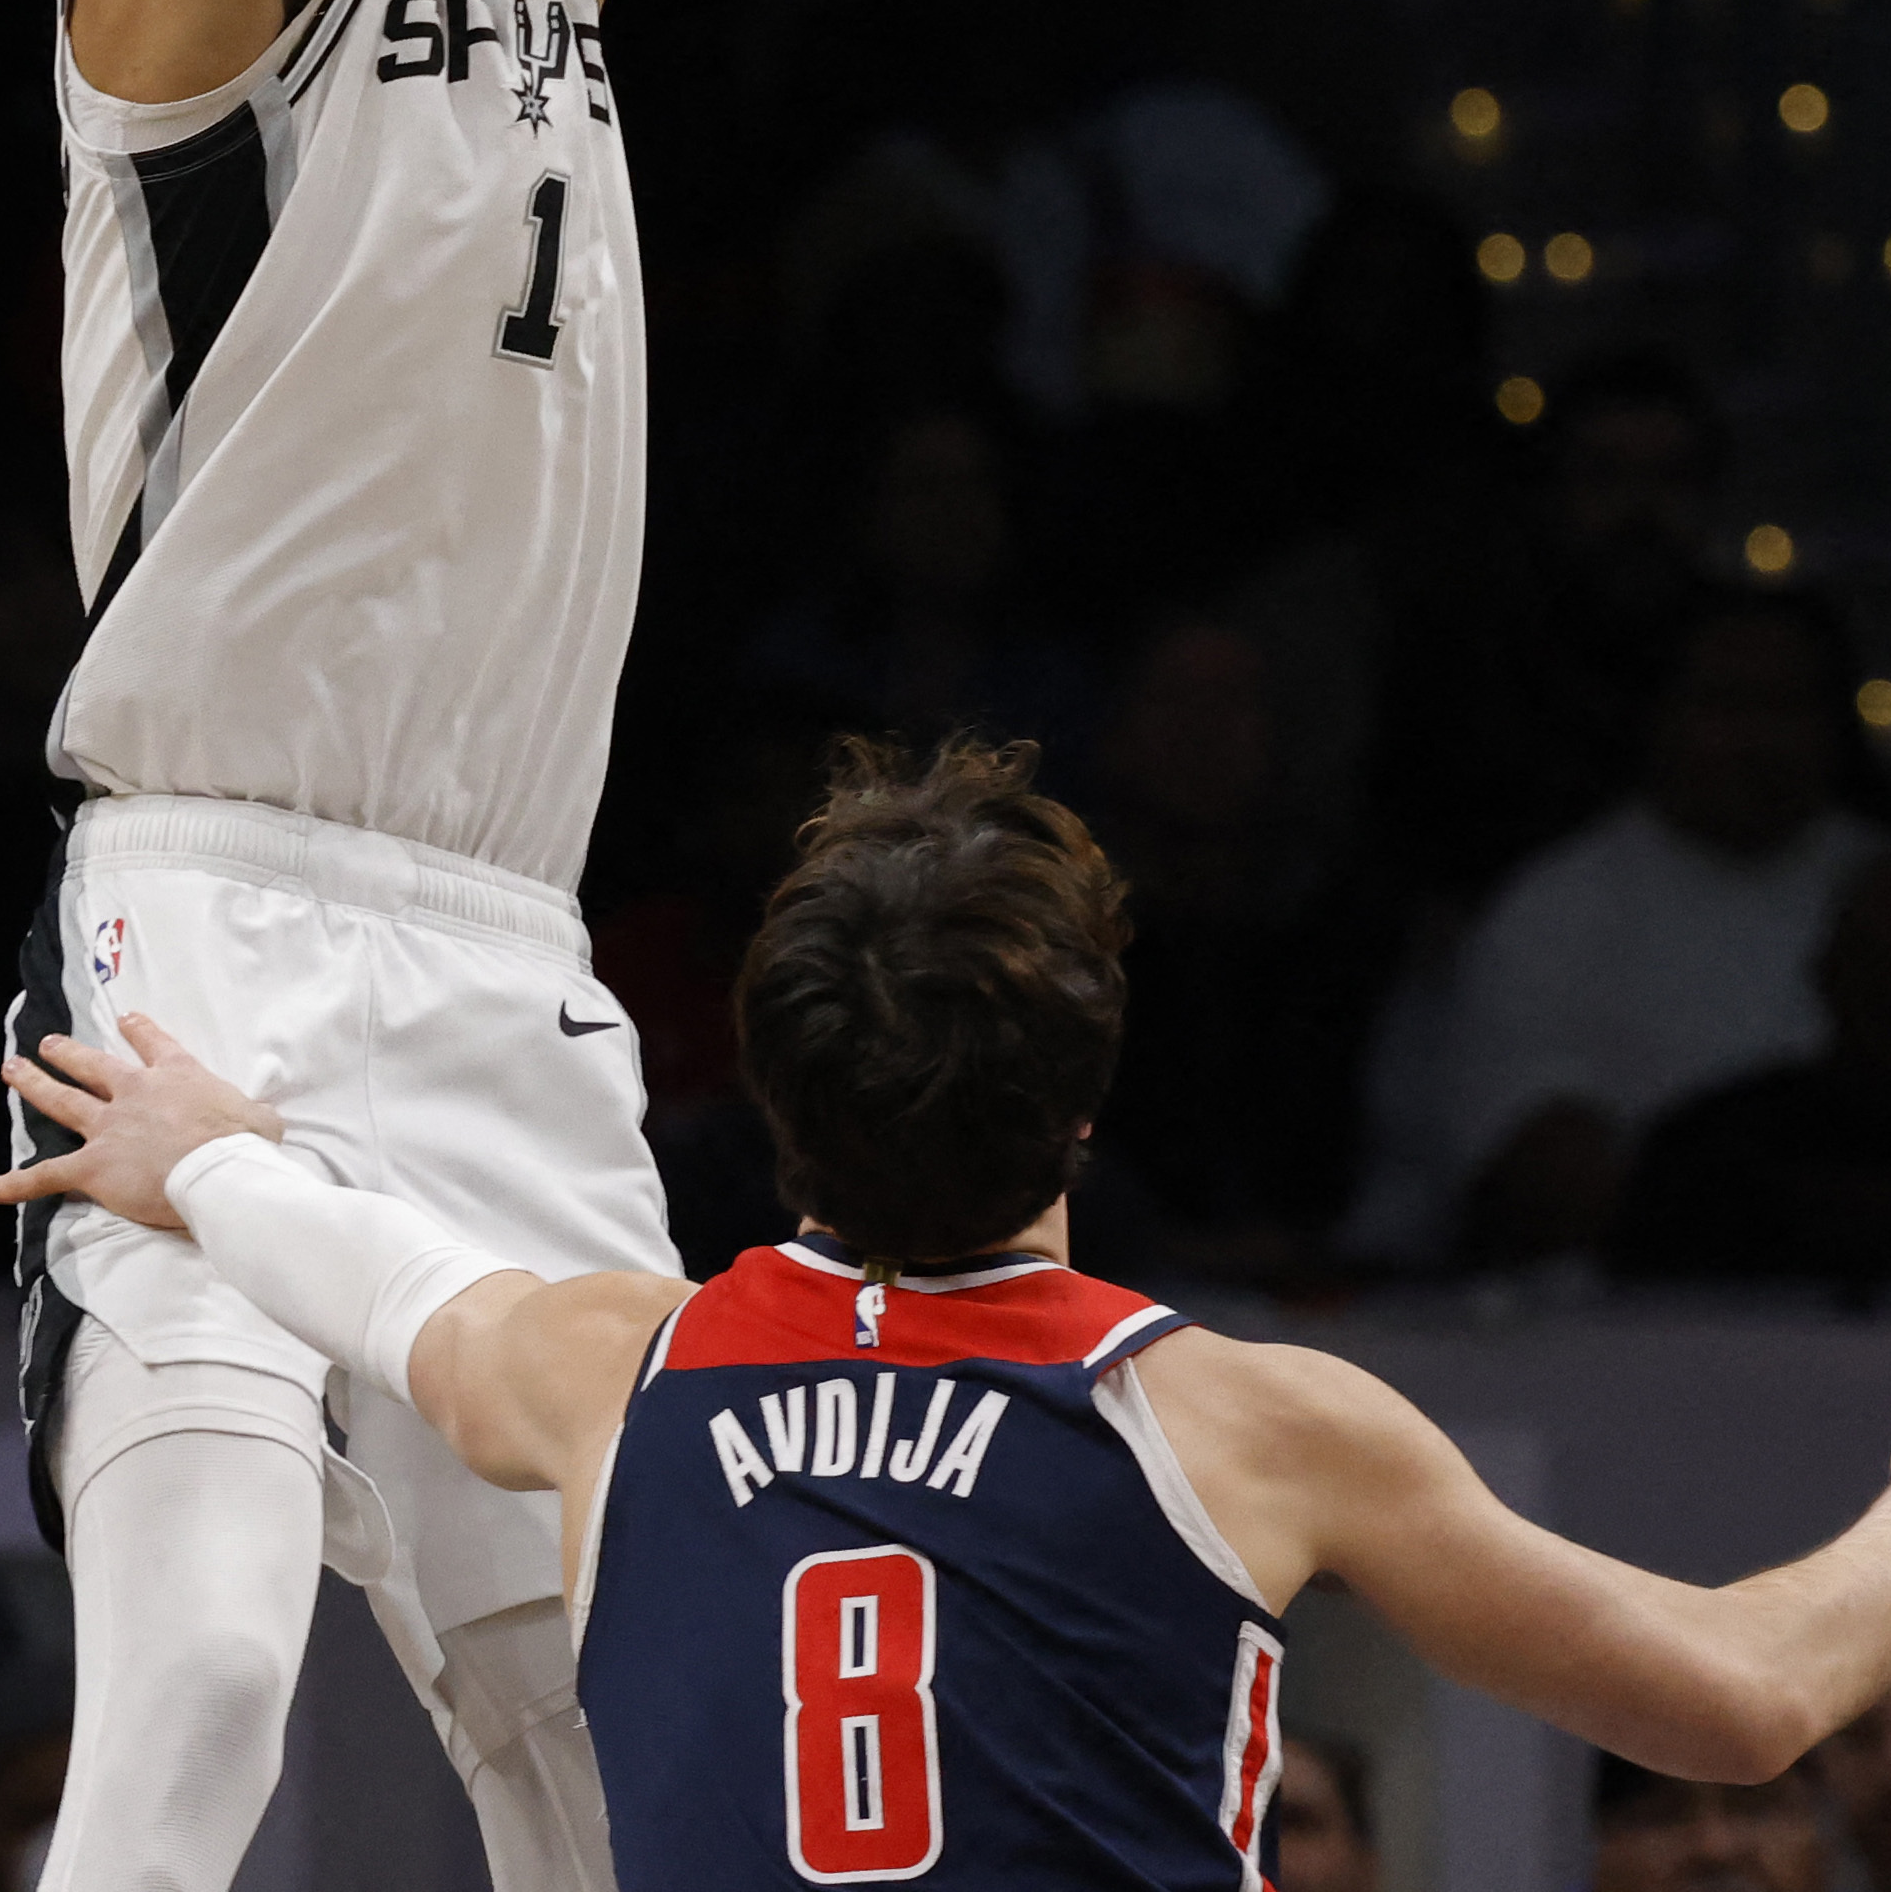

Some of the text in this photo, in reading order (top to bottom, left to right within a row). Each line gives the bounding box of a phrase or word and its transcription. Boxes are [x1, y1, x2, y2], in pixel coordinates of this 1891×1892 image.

[492, 168, 571, 370] 1
[709, 1371, 1011, 1508] AVDIJA
[782, 1543, 944, 1885] 8
